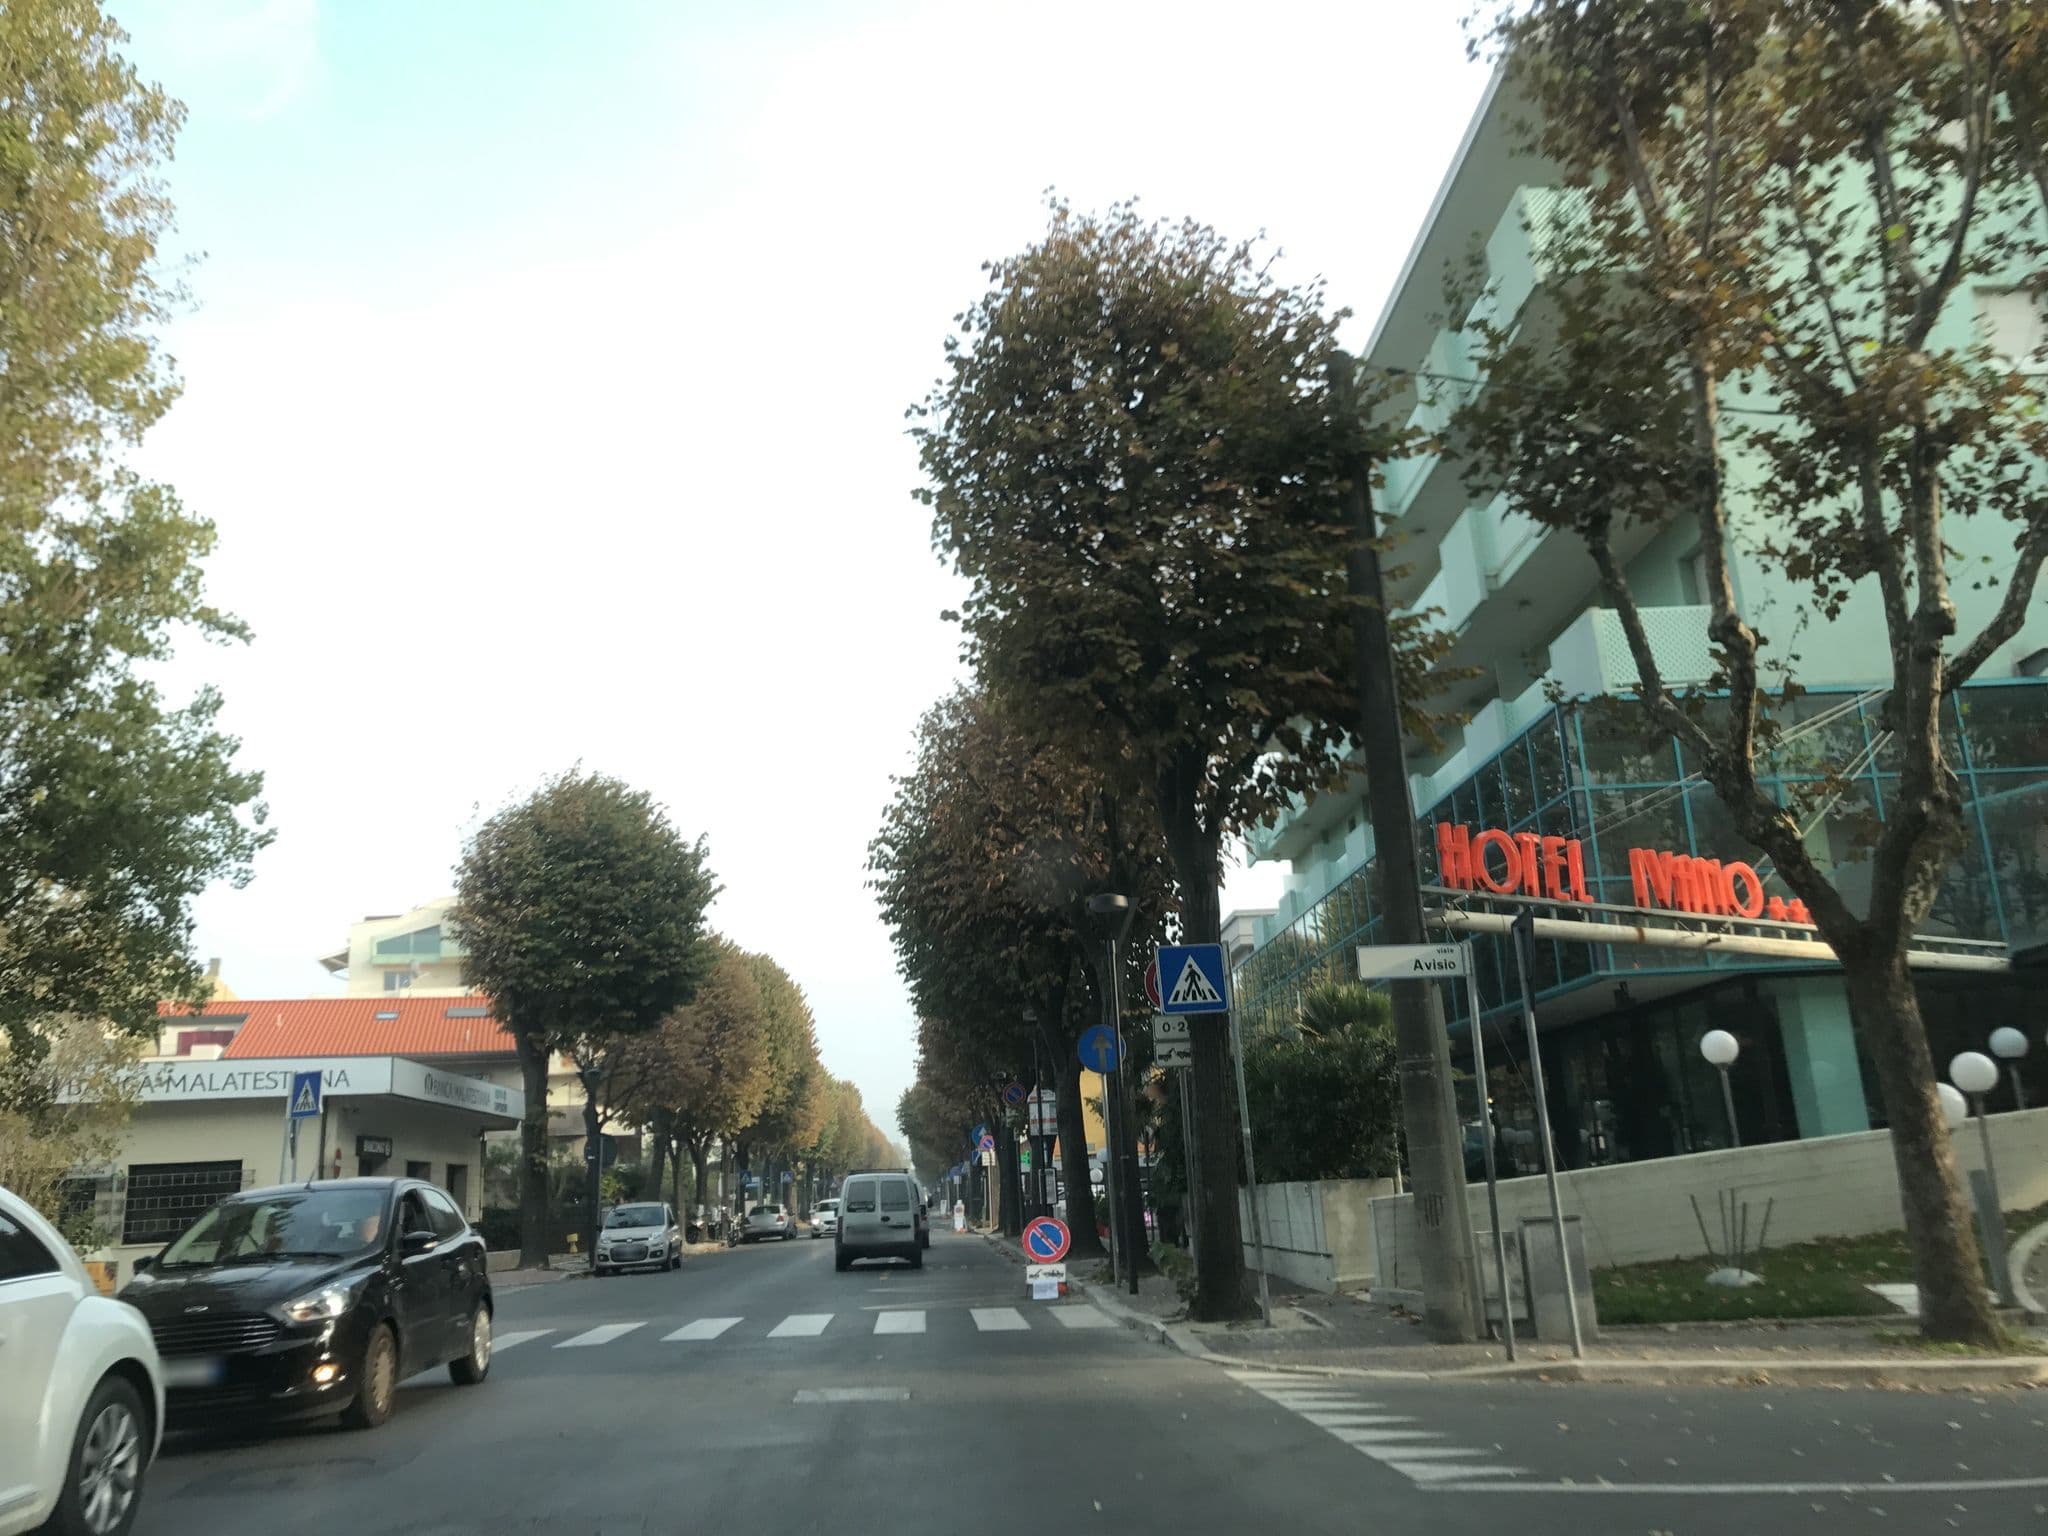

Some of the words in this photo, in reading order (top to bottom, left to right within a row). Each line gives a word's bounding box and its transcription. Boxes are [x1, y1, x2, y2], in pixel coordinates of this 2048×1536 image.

[1436, 822, 1594, 904] HOTEL
[1413, 959, 1456, 971] Avisio
[1162, 1021, 1190, 1033] 0-2
[164, 1069, 351, 1095] MALATESTNA
